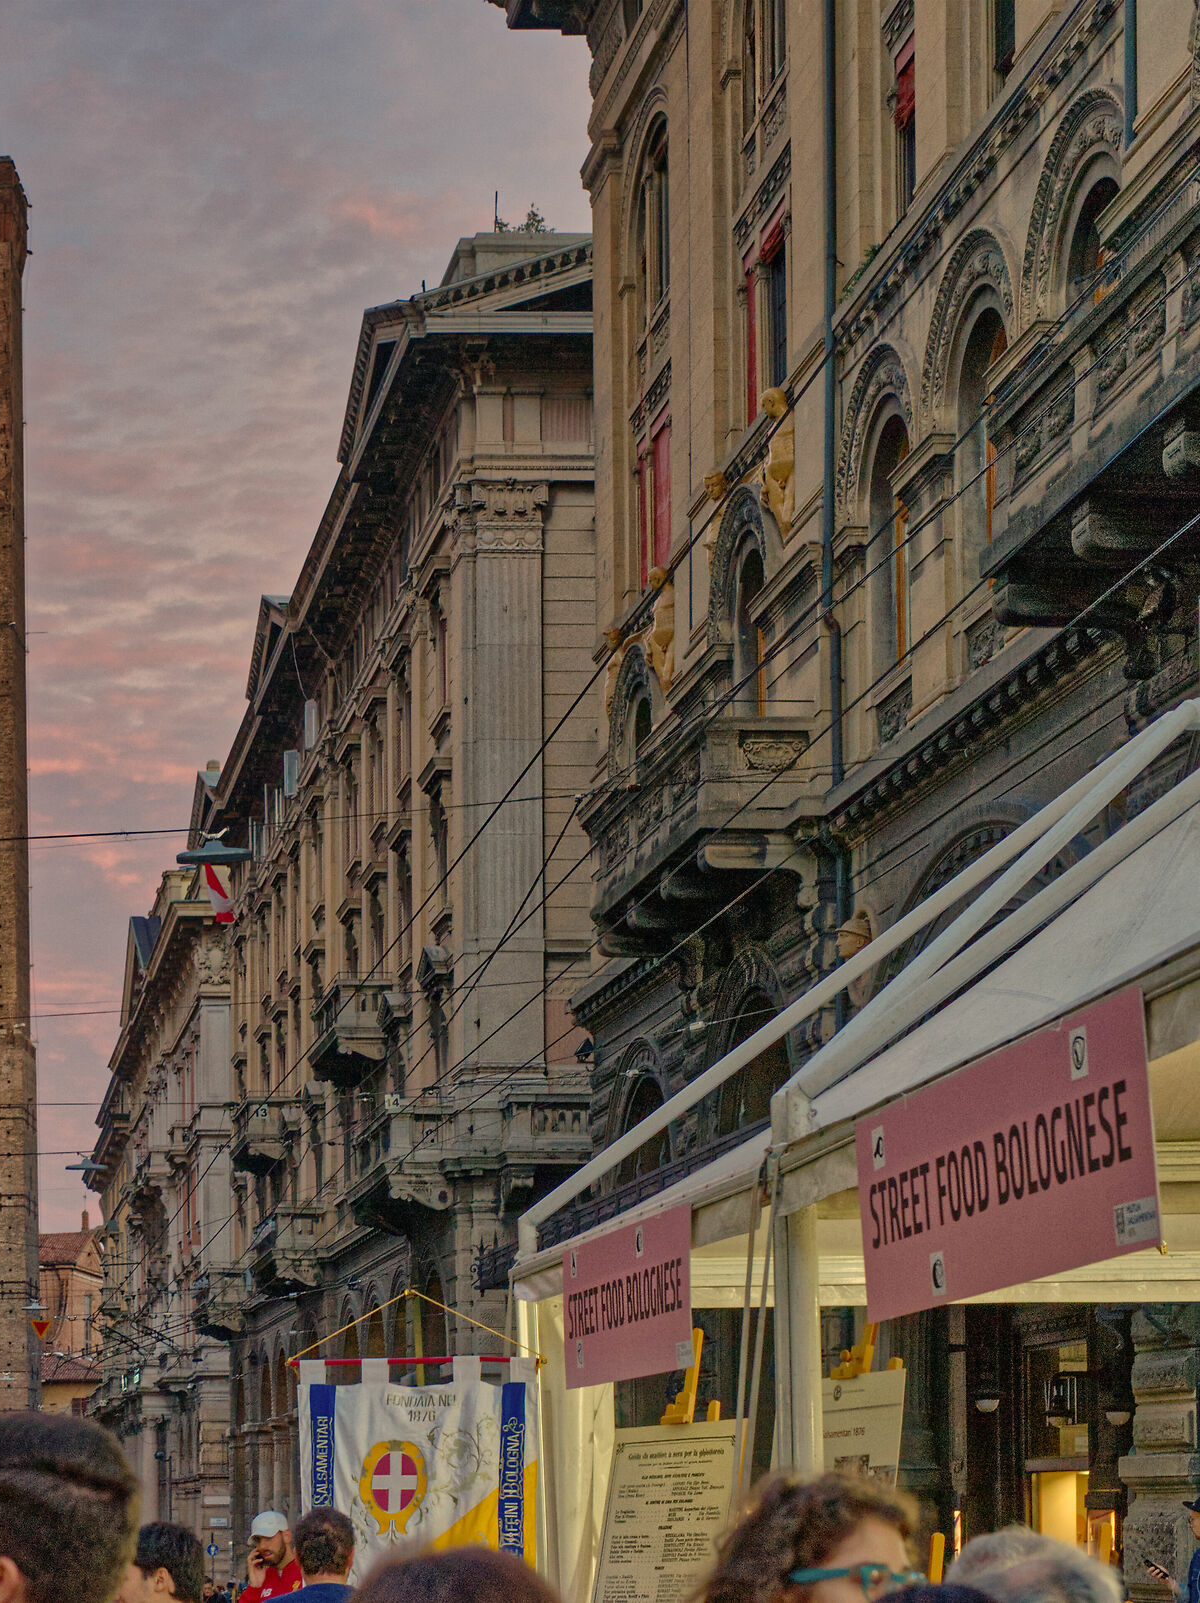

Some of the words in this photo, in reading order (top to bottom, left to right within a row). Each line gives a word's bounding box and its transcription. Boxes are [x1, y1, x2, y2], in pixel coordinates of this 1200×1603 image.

[869, 1162, 930, 1249] STREET
[935, 1140, 990, 1226] FOOD
[993, 1079, 1133, 1206] BOLOGNESE
[568, 1286, 599, 1339] STREET
[600, 1278, 626, 1332] FOOD
[626, 1257, 683, 1324] BOLOGNESE
[408, 1410, 437, 1422] 1876
[313, 1416, 330, 1505] SALSAMENTARI
[501, 1434, 520, 1494] BOLOGNA
[501, 1502, 519, 1545] AFFINI
[260, 1588, 273, 1598] NB
